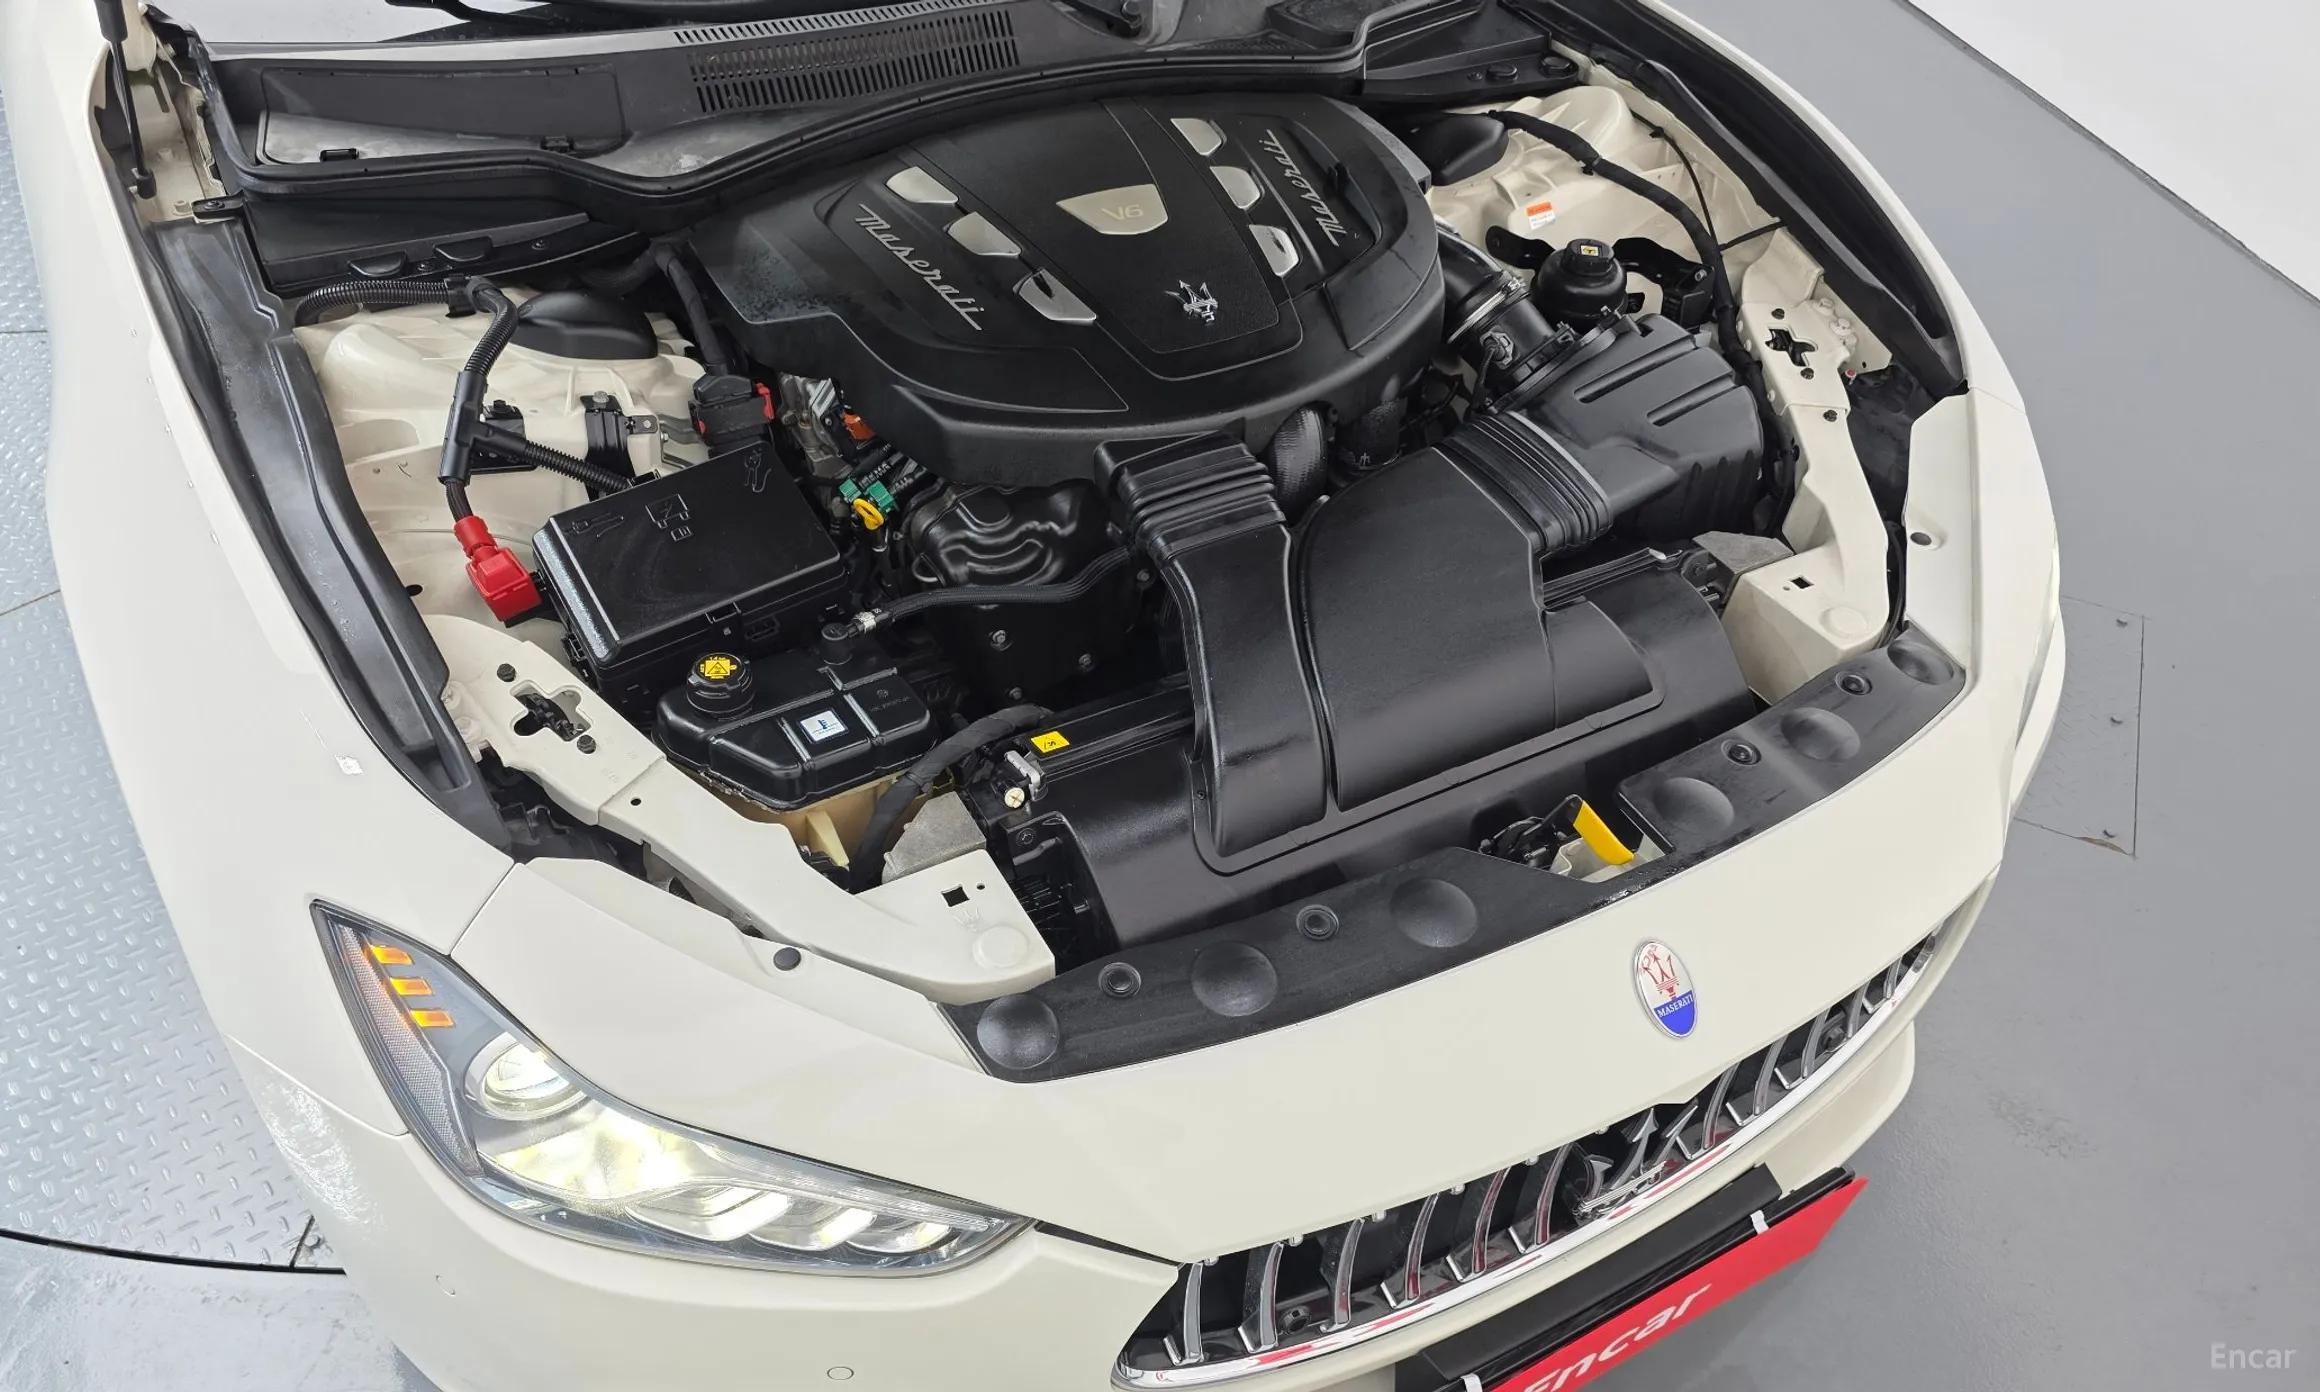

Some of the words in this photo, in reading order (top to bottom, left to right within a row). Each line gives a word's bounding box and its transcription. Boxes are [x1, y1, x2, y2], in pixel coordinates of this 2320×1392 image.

[1101, 204, 1144, 221] V6
[1259, 129, 1347, 247] Maserati
[855, 203, 985, 331] Maserati
[1656, 994, 1694, 1018] MASERATI
